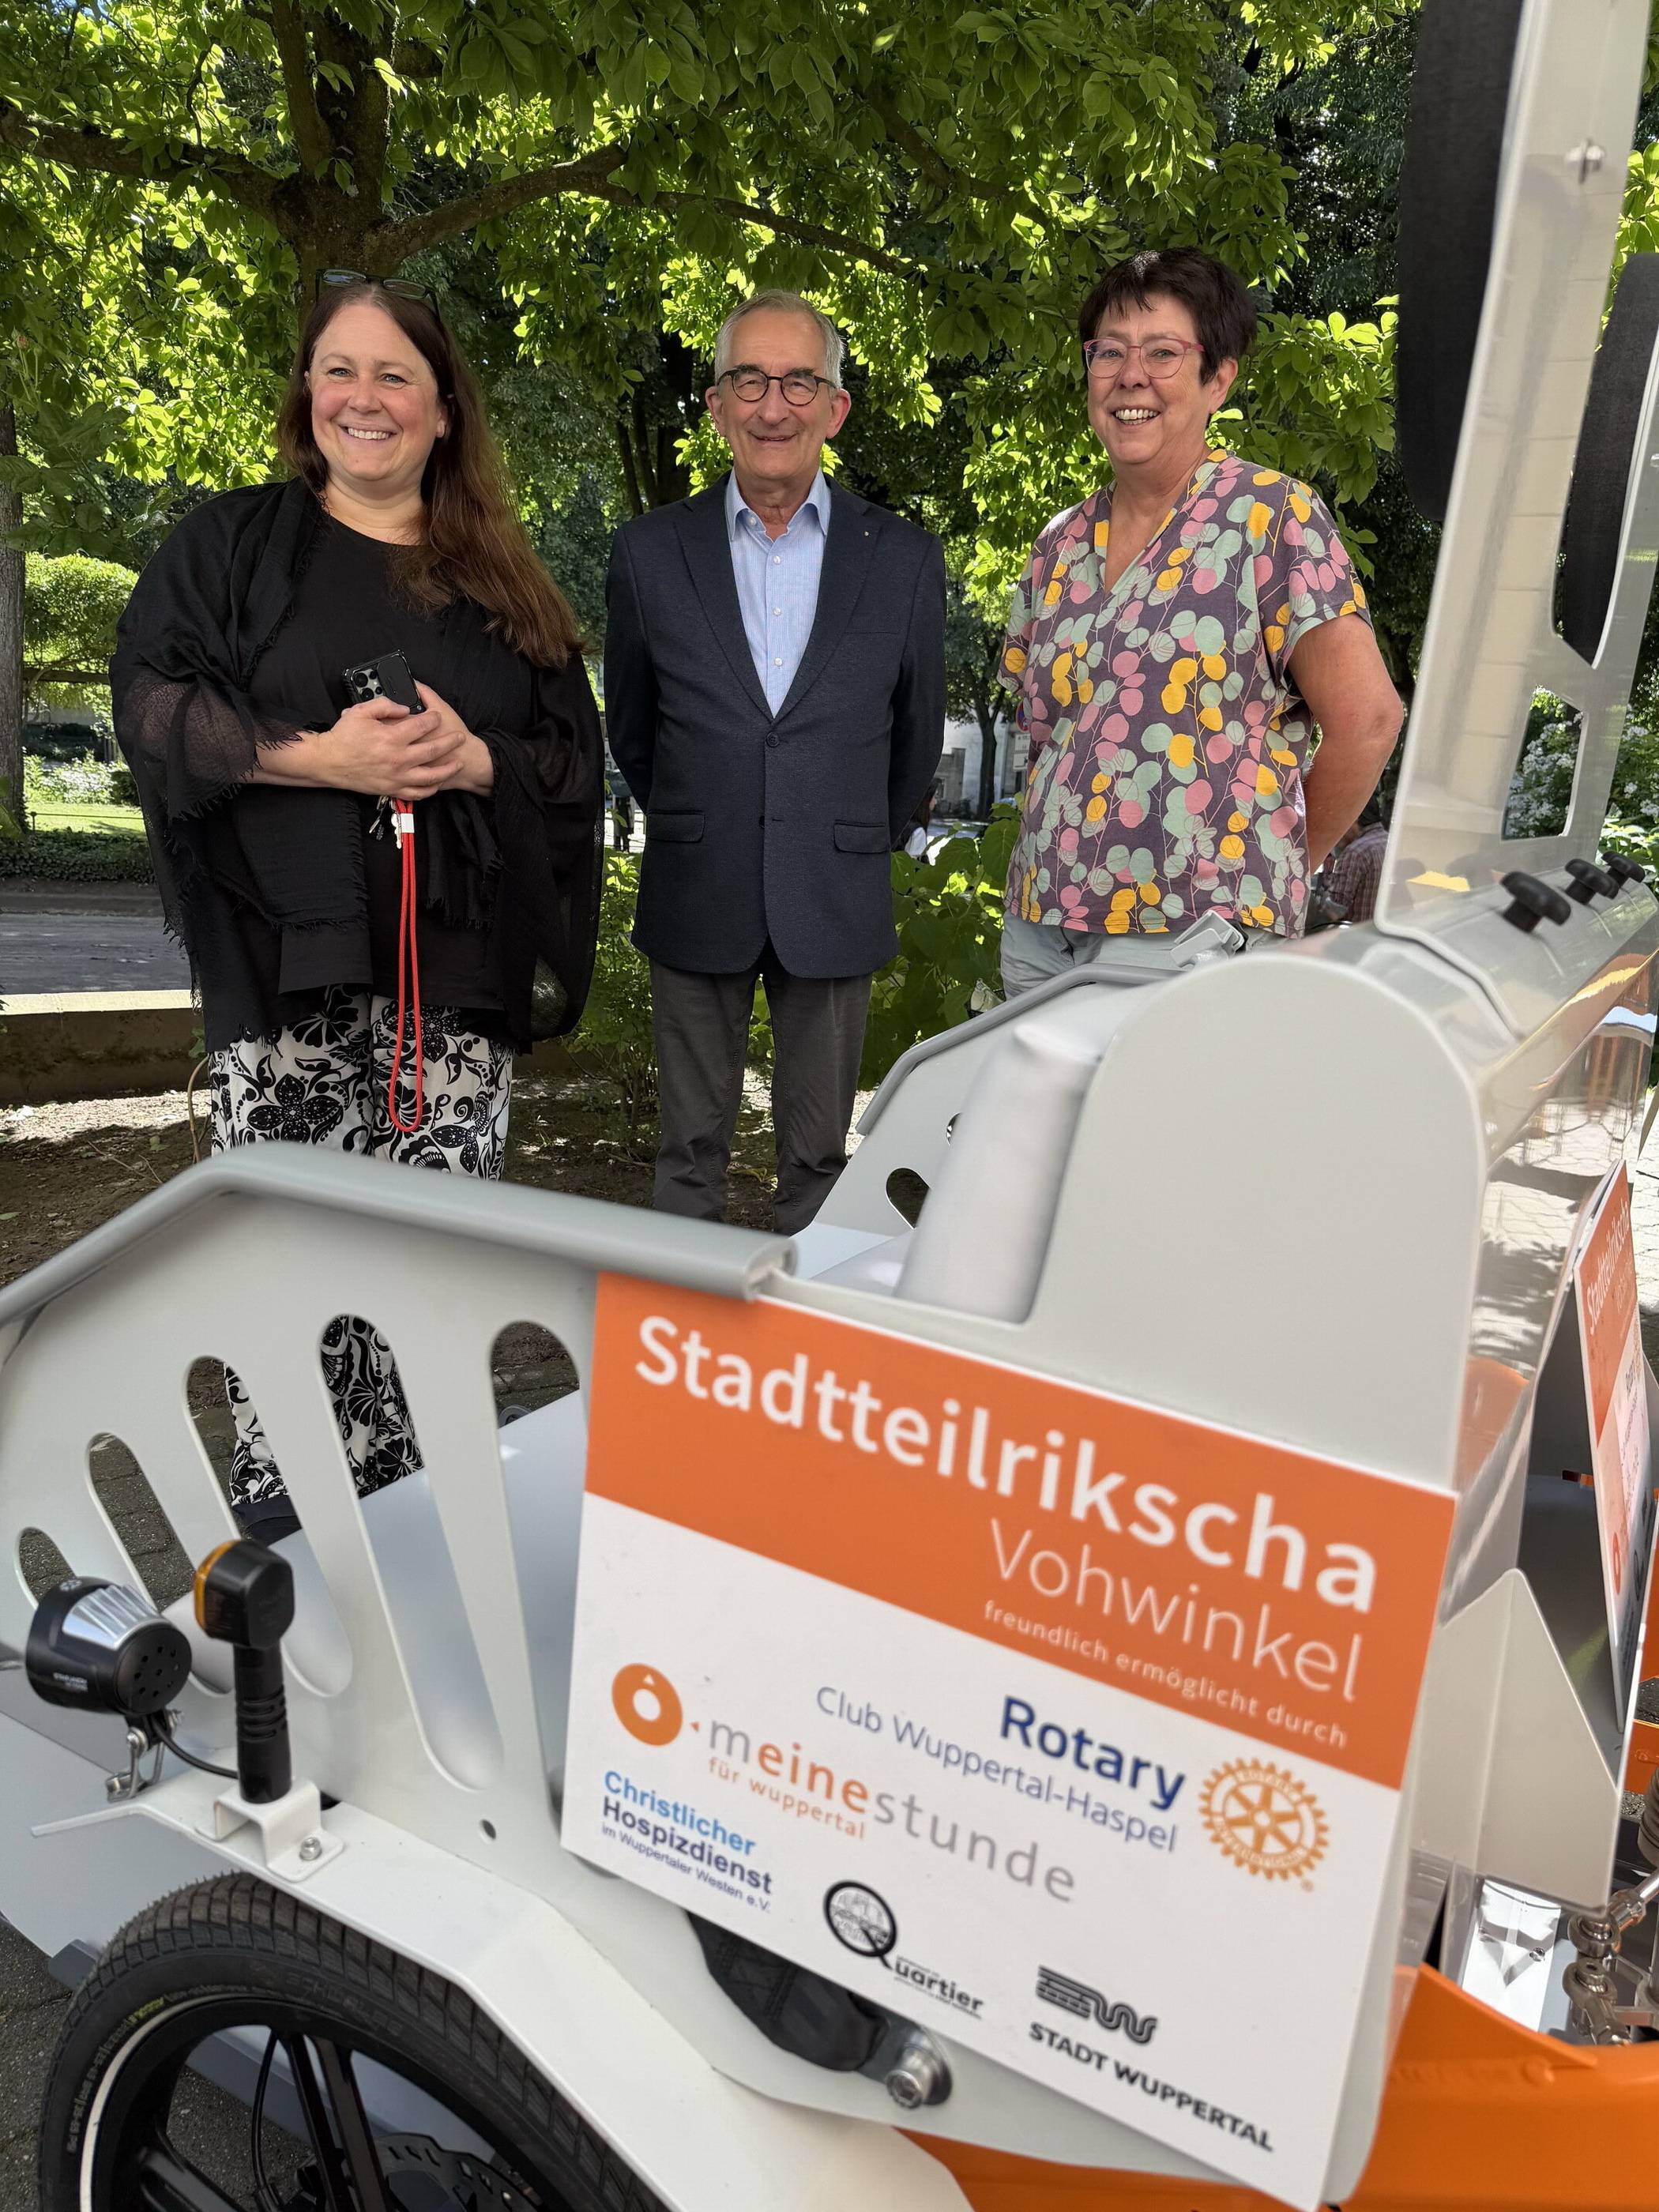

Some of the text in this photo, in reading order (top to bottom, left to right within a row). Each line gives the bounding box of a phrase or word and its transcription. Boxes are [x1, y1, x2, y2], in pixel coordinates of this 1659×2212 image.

[636, 1316, 1377, 1613] Stadtteilrikscha
[984, 1600, 1348, 1748] freundlich ermöglicht durch
[991, 1518, 1362, 1703] Vohwinkel
[604, 1770, 756, 1856] Christlicher
[709, 1757, 867, 1839] für wuppertal
[709, 1719, 1077, 1903] meinestunde
[816, 1686, 882, 1734] Club
[893, 1714, 1178, 1853] Wuppertal-Haspel
[1000, 1695, 1186, 1811] Rotary
[601, 1822, 771, 1913] im Wuppertaler Westen e.V.
[603, 1795, 773, 1895] Hospizdienst
[822, 1879, 984, 2011] Quartier
[1029, 2022, 1273, 2153] STADT WUPPERTAL
